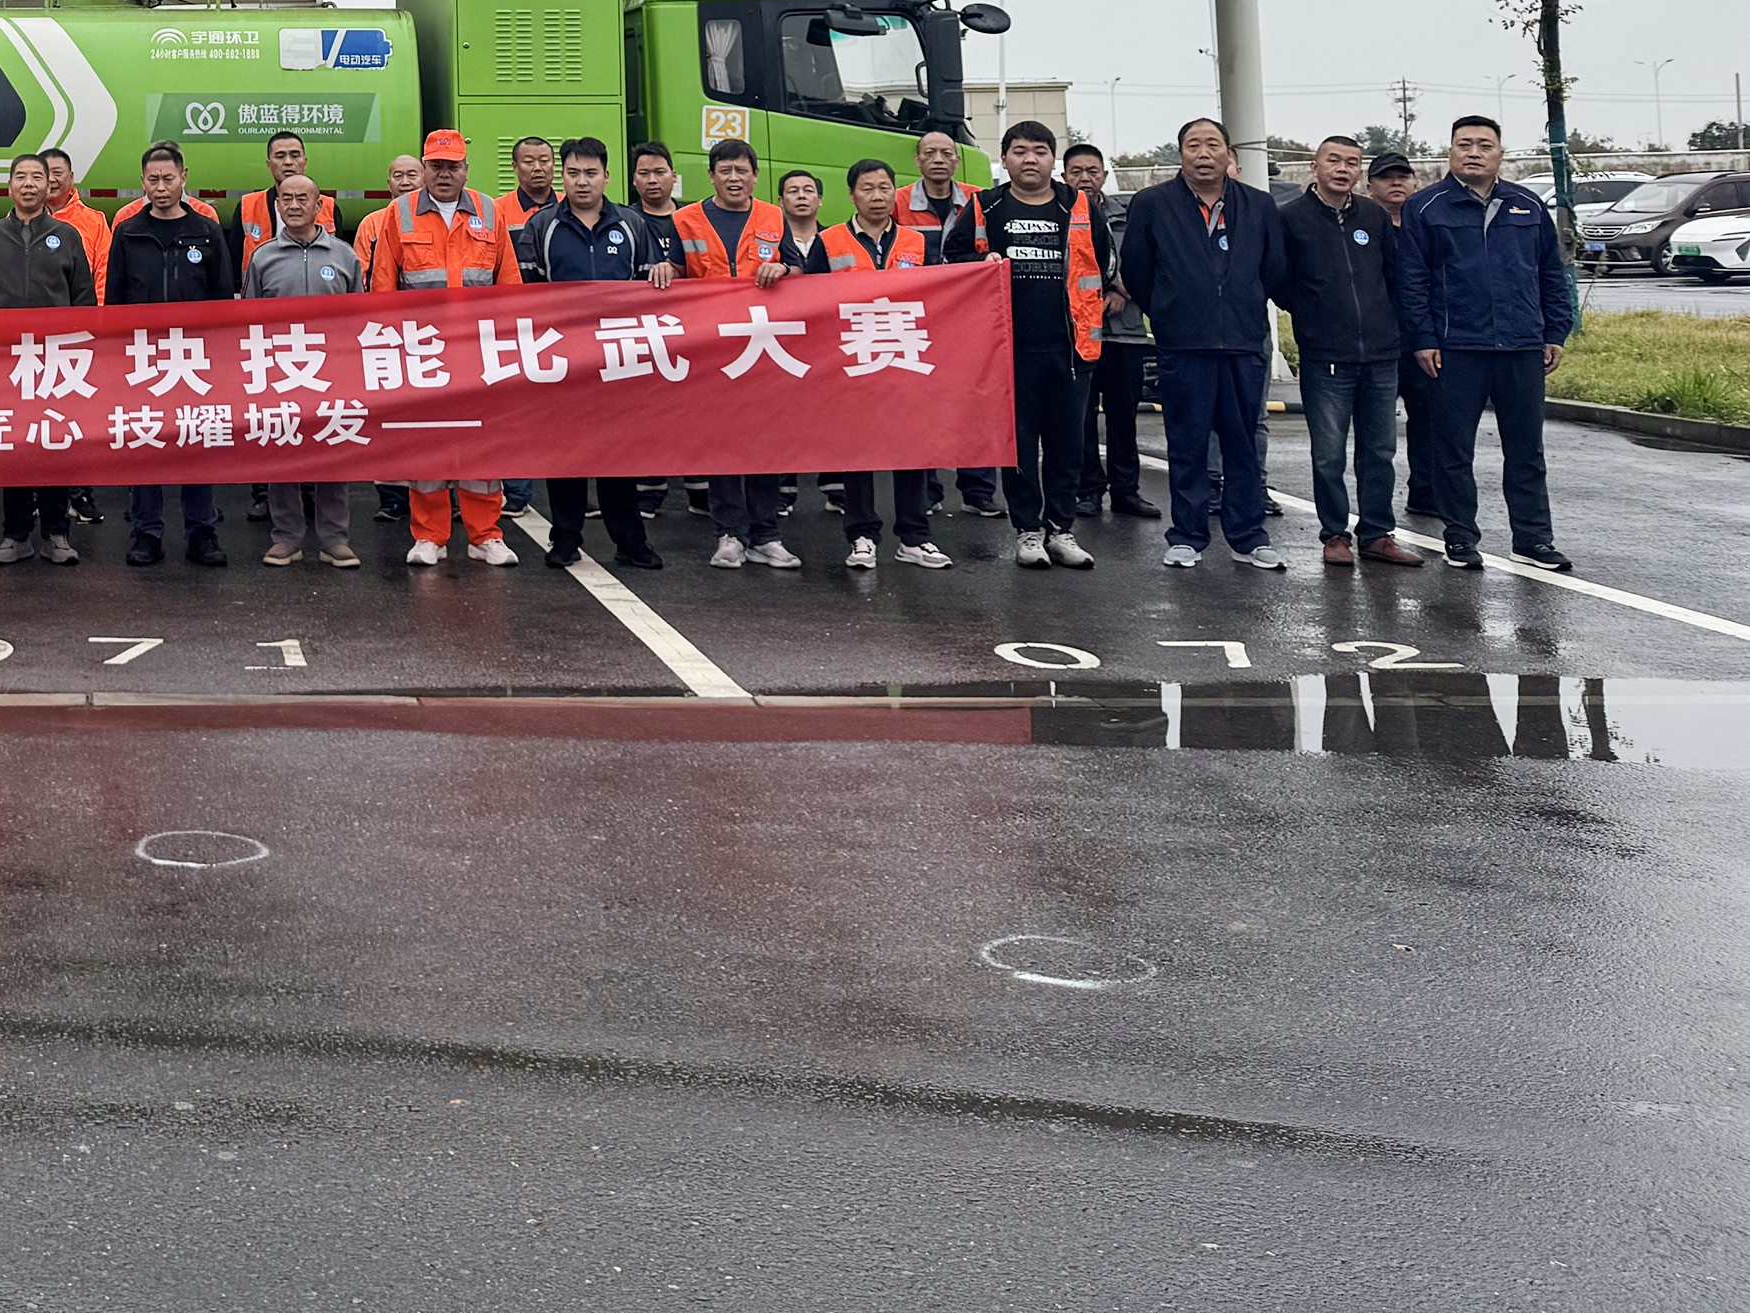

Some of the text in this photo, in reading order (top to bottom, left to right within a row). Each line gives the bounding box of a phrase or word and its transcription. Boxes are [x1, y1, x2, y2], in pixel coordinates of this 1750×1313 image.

[191, 30, 260, 44] 宇通环卫
[339, 54, 382, 65] 电动汽车
[238, 104, 344, 124] 傲蓝得环境
[238, 127, 276, 135] OURLAND
[709, 111, 743, 137] 23
